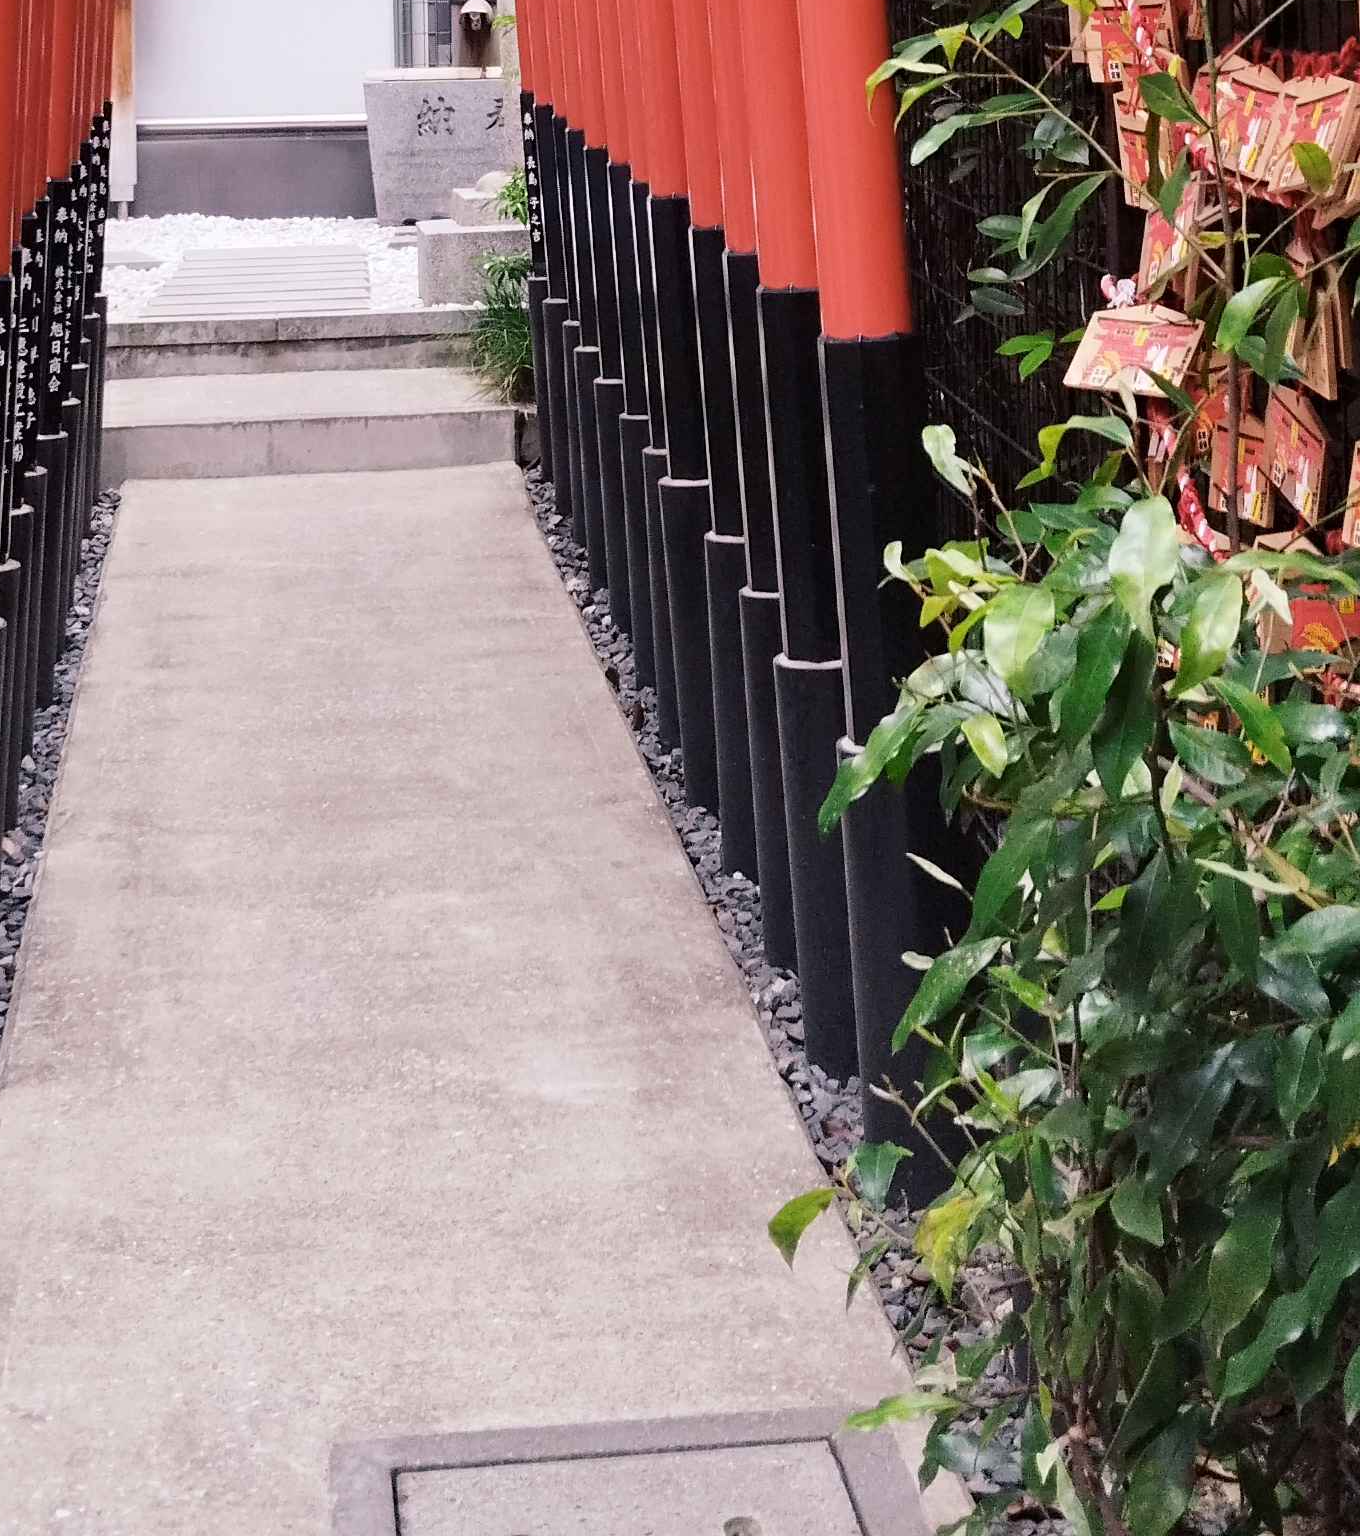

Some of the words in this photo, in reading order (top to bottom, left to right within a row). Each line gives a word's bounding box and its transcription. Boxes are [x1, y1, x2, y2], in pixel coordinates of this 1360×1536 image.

[53, 205, 69, 245] 奉納
[53, 264, 66, 315] 株式会社
[48, 319, 65, 393] 旭日商会
